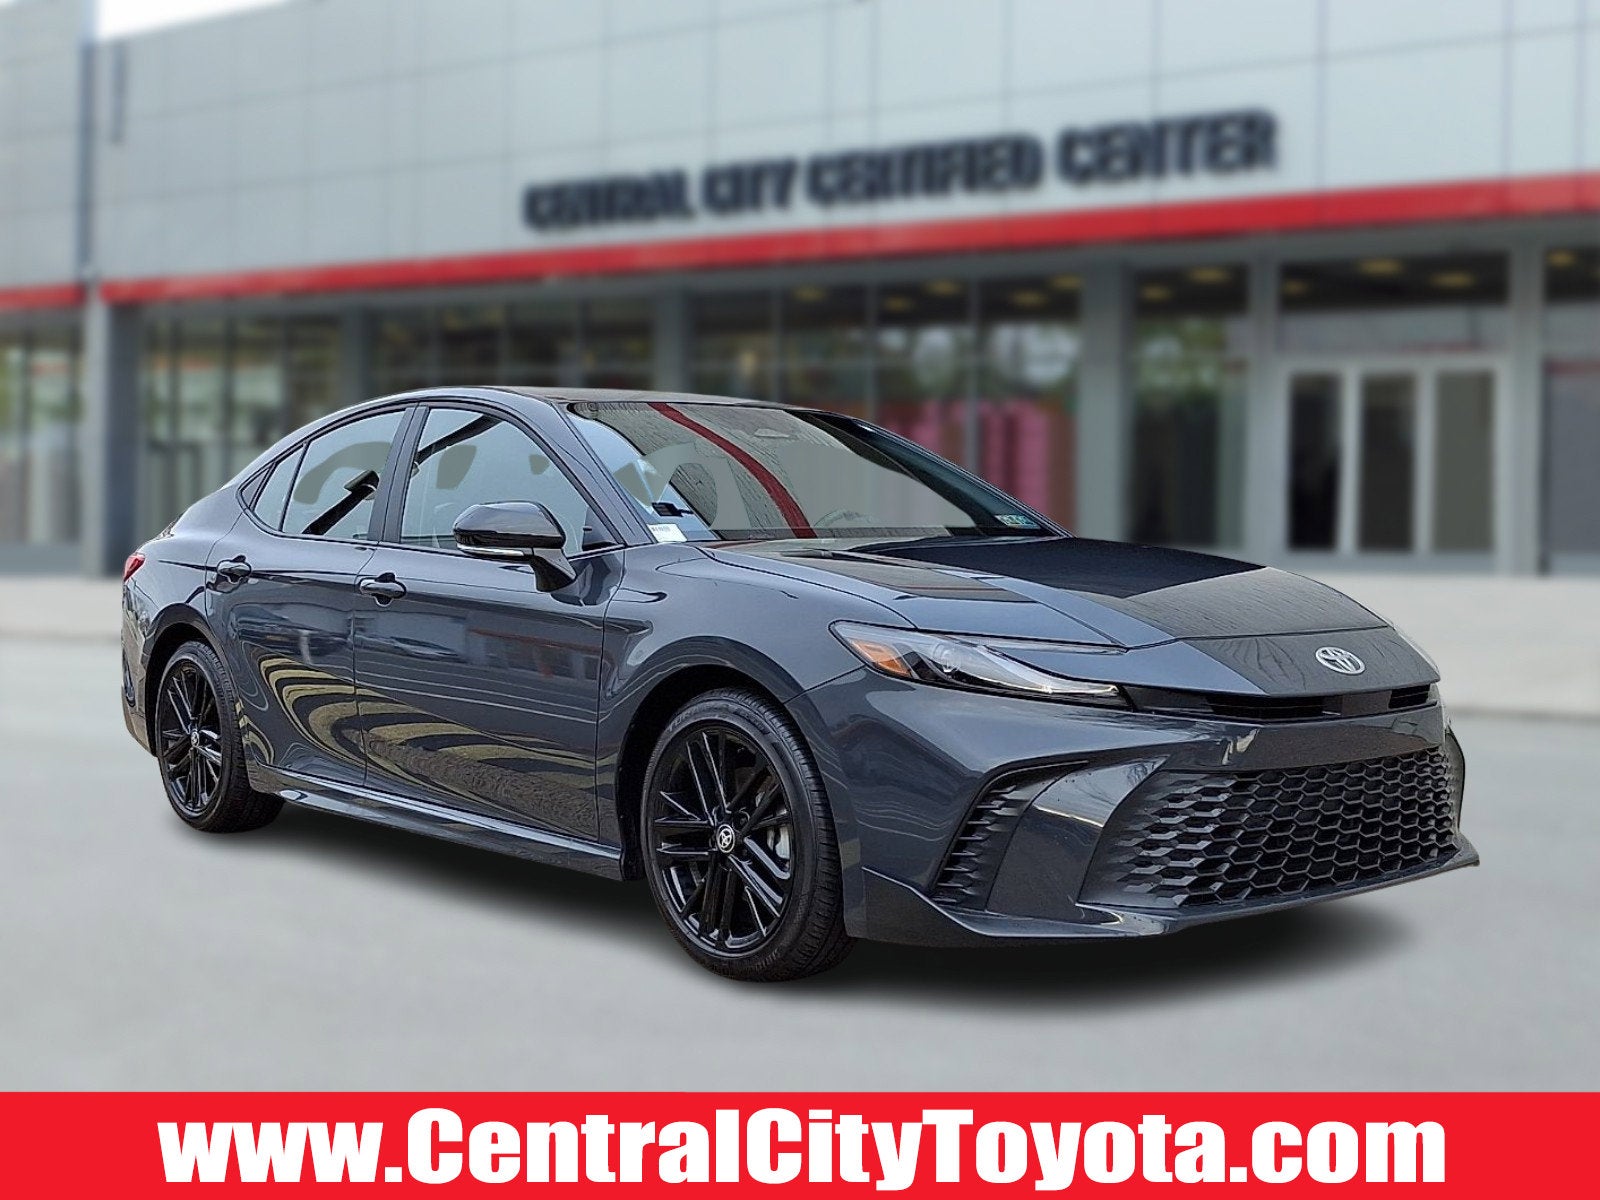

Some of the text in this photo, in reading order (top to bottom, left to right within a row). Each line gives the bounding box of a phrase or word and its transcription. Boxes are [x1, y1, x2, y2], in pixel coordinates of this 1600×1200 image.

[703, 156, 798, 216] CITY
[806, 132, 1044, 206] CERTIFIED
[1056, 107, 1277, 186] CENTER
